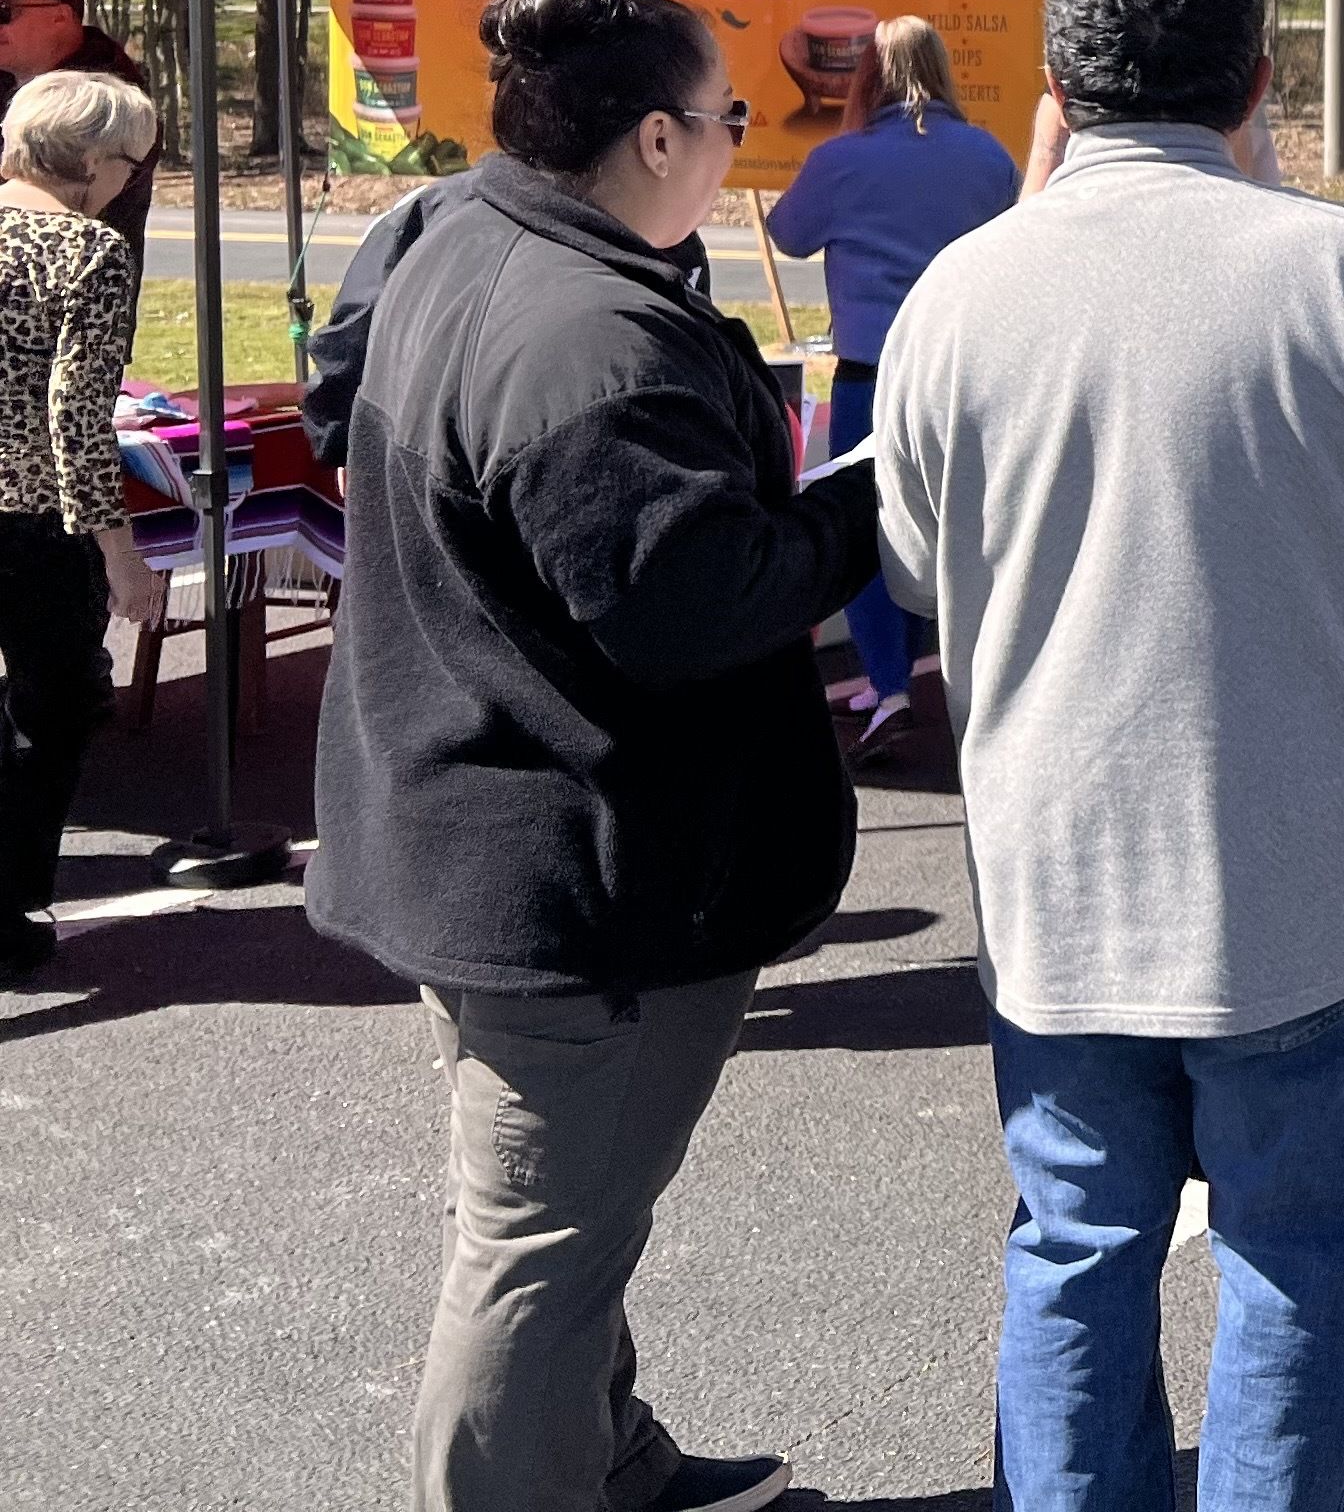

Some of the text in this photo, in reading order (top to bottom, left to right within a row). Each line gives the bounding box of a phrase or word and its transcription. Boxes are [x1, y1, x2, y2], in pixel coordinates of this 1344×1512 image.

[928, 14, 1009, 32] MILD SALSA
[953, 50, 983, 67] DIPS
